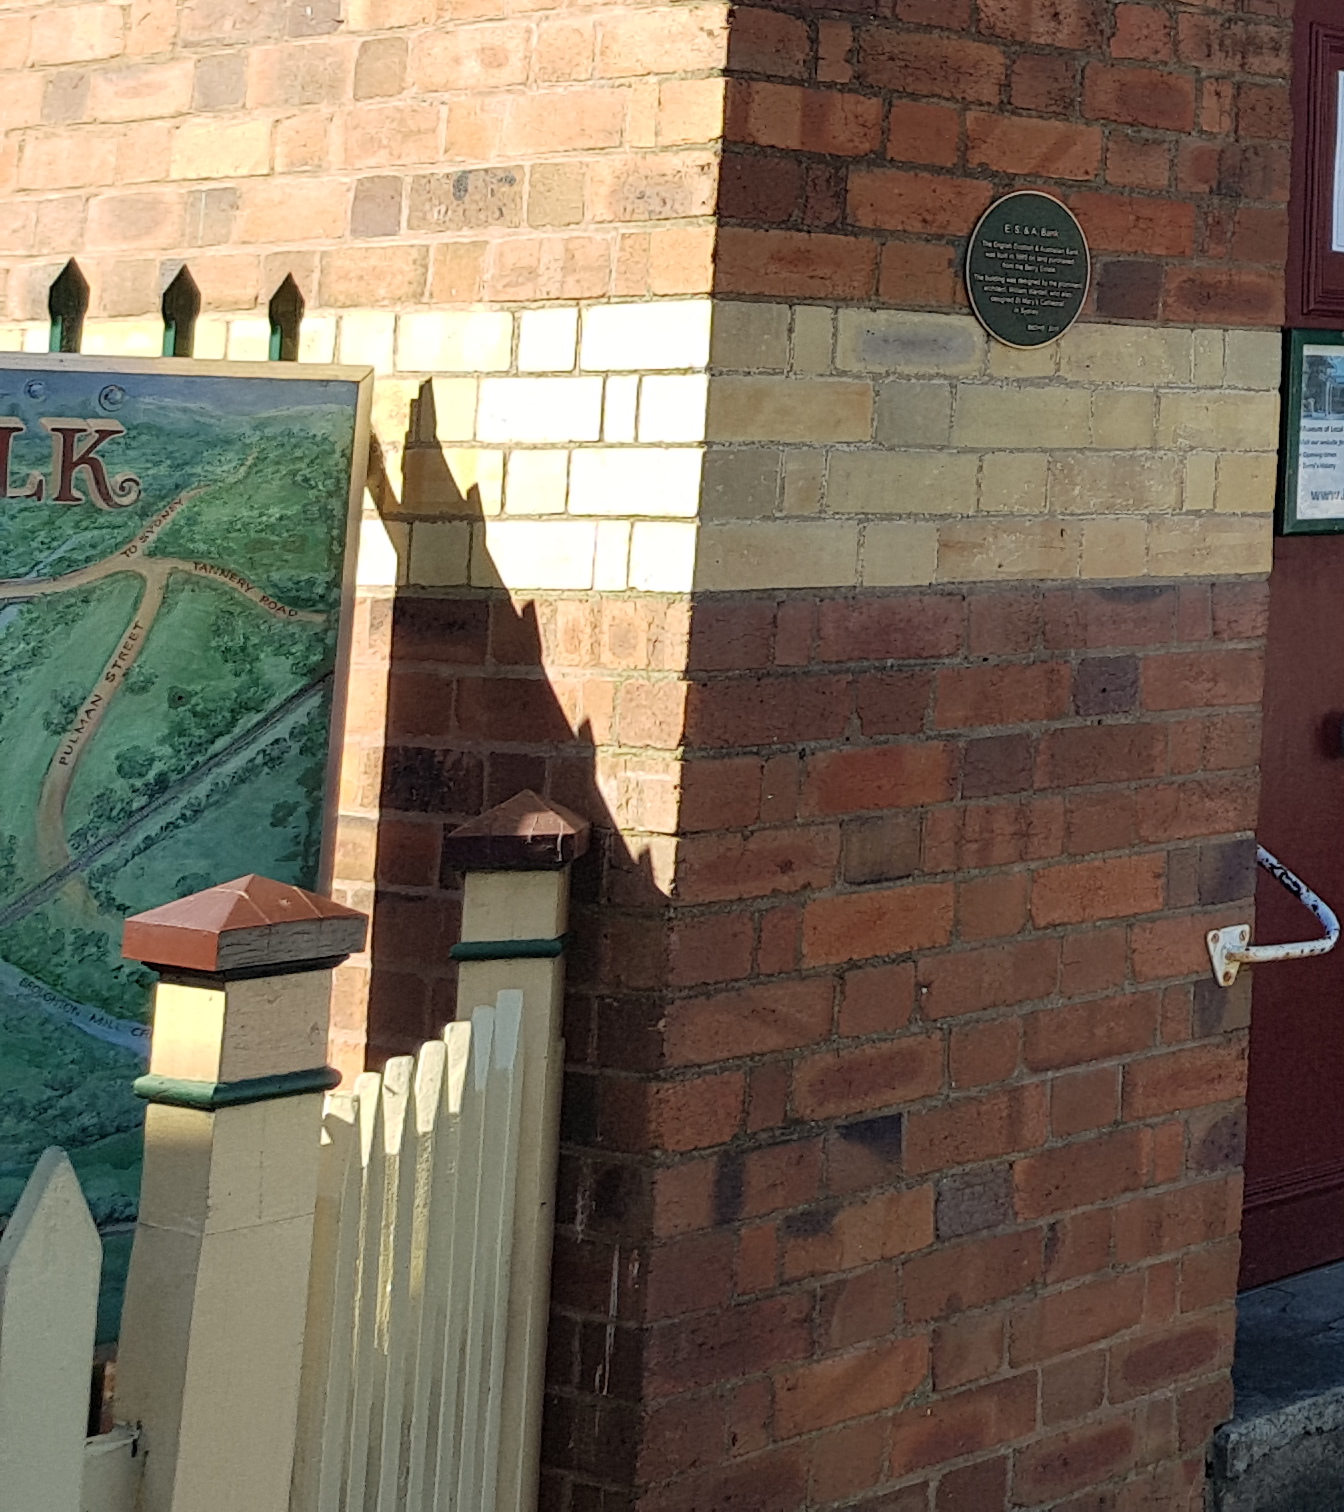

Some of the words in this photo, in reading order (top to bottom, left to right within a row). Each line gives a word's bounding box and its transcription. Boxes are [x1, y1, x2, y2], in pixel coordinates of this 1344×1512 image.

[119, 545, 138, 558] TO
[139, 499, 184, 543] SYDNEY
[192, 561, 256, 593] TANNERY
[259, 595, 298, 617] ROAD
[59, 693, 103, 766] PULMAN
[105, 620, 144, 683] STREET
[89, 1013, 120, 1030] MILL
